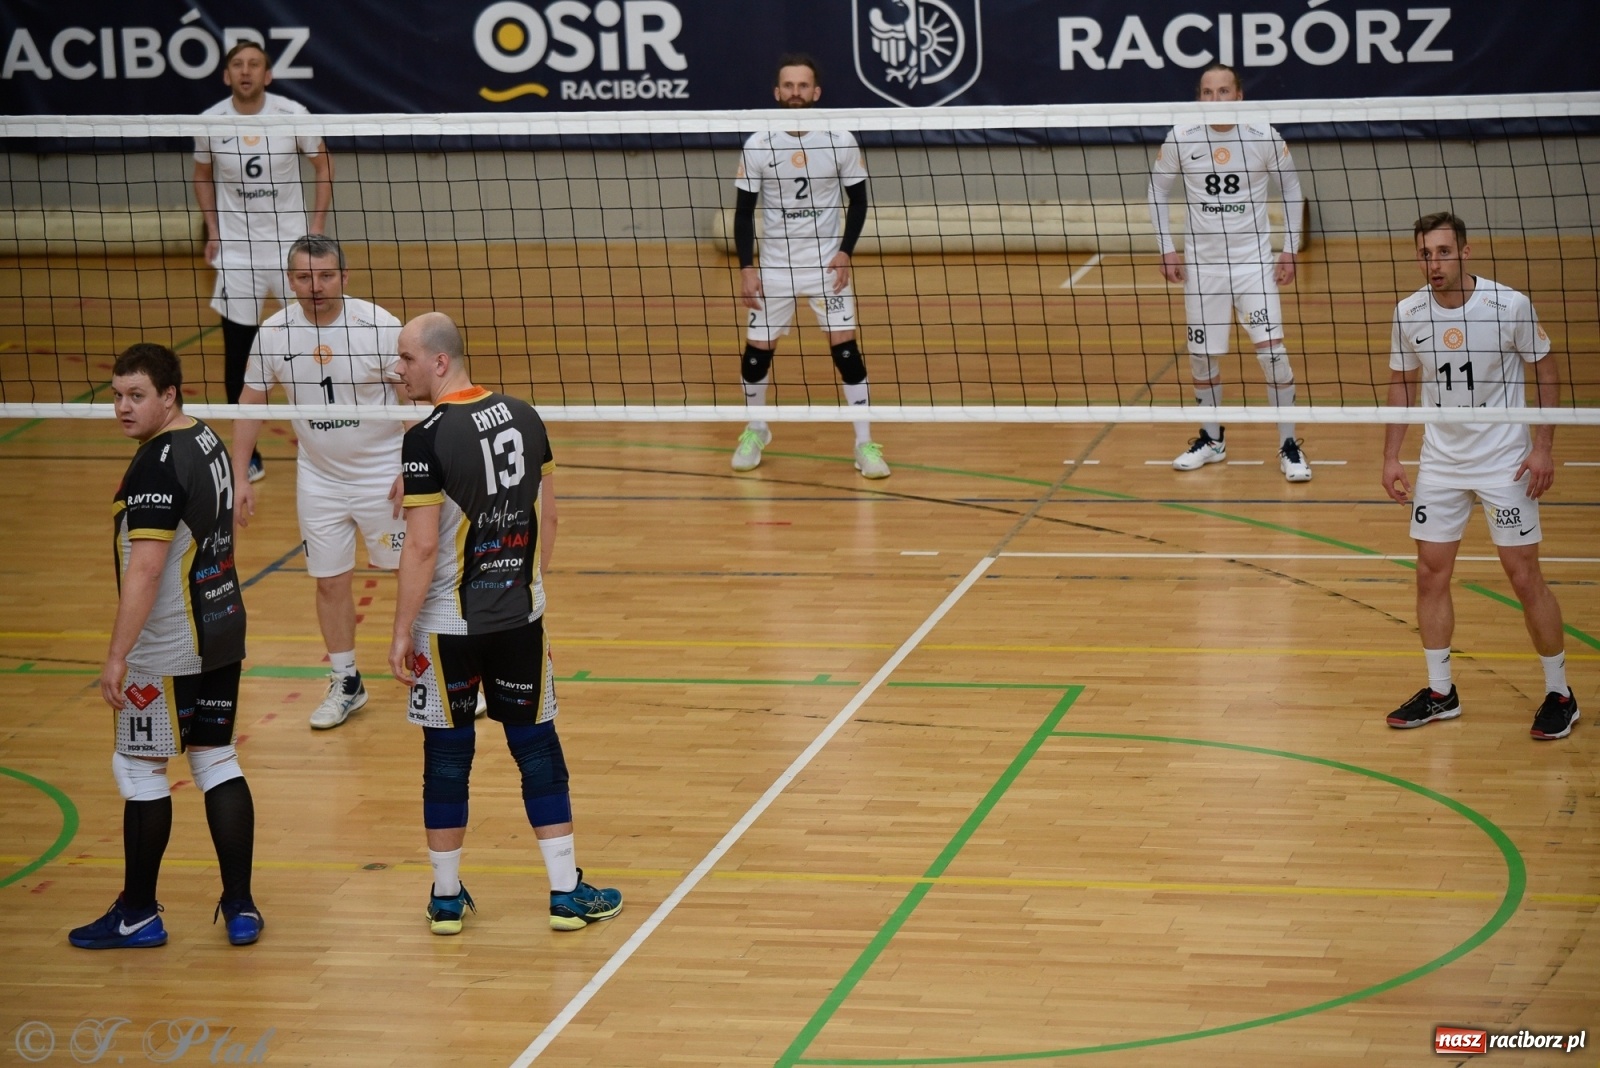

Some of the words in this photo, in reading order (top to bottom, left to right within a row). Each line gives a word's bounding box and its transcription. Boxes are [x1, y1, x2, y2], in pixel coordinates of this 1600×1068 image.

[473, 0, 688, 73] OSiR
[1057, 0, 1454, 71] RACIBÓRZ
[560, 74, 690, 100] RACIBÓRZ
[245, 156, 263, 179] 6
[794, 176, 809, 200] 2
[1205, 173, 1240, 196] 88
[1202, 202, 1246, 214] TropiDog
[749, 312, 757, 329] 2
[1438, 361, 1475, 391] 11
[319, 376, 336, 404] 1
[471, 402, 513, 433] ENTER
[479, 427, 526, 496] 13
[209, 450, 233, 519] 14
[1496, 507, 1521, 518] ZOO
[1496, 515, 1522, 525] MAR
[480, 558, 524, 572] GRAVTON
[205, 580, 234, 600] GRAVTON
[130, 686, 148, 704] Enter
[495, 678, 533, 690] GRAVTON
[129, 716, 153, 742] 14
